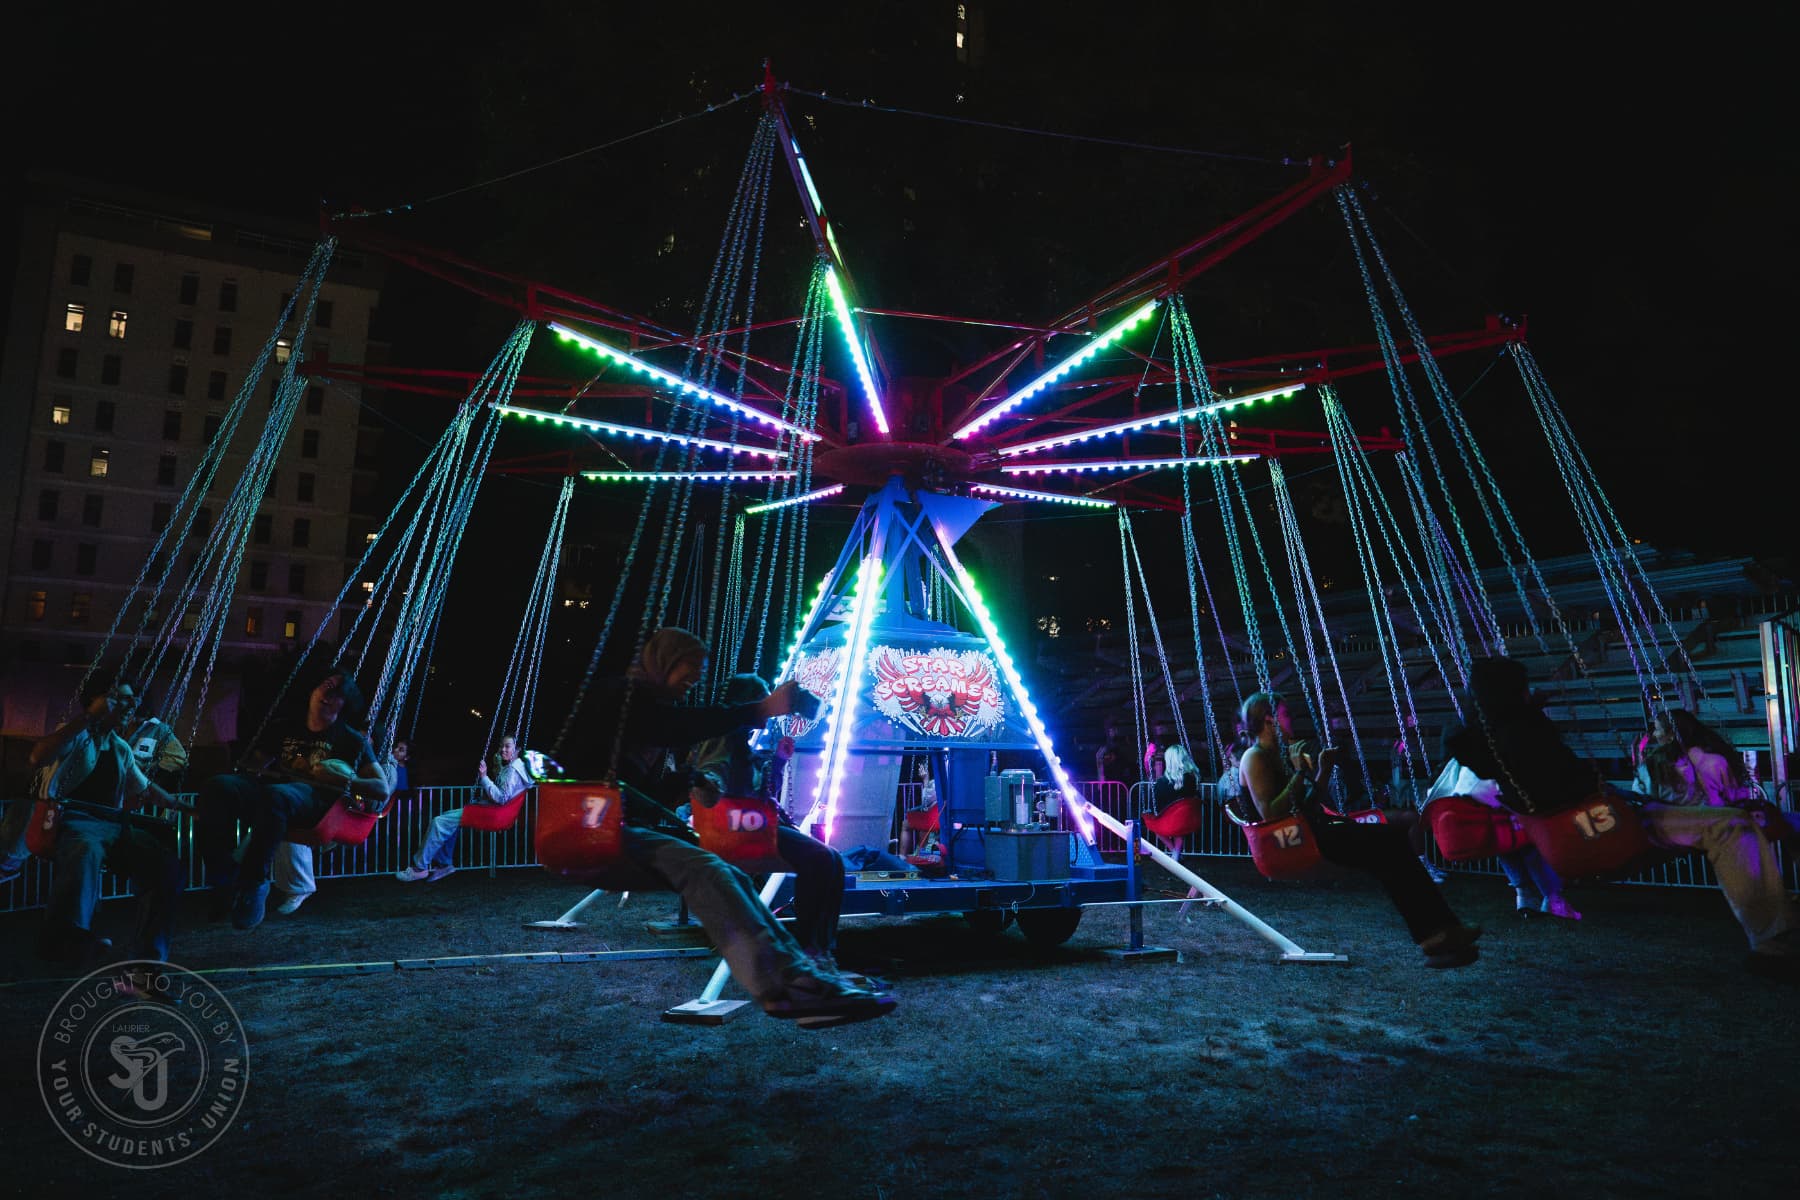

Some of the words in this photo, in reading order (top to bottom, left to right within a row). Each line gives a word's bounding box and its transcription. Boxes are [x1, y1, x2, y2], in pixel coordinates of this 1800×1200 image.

[902, 655, 966, 679] STAR
[877, 676, 998, 707] SCREAMER
[582, 797, 609, 828] 7
[727, 809, 765, 832] 10
[1574, 804, 1617, 838] 13
[1273, 825, 1302, 848] 12
